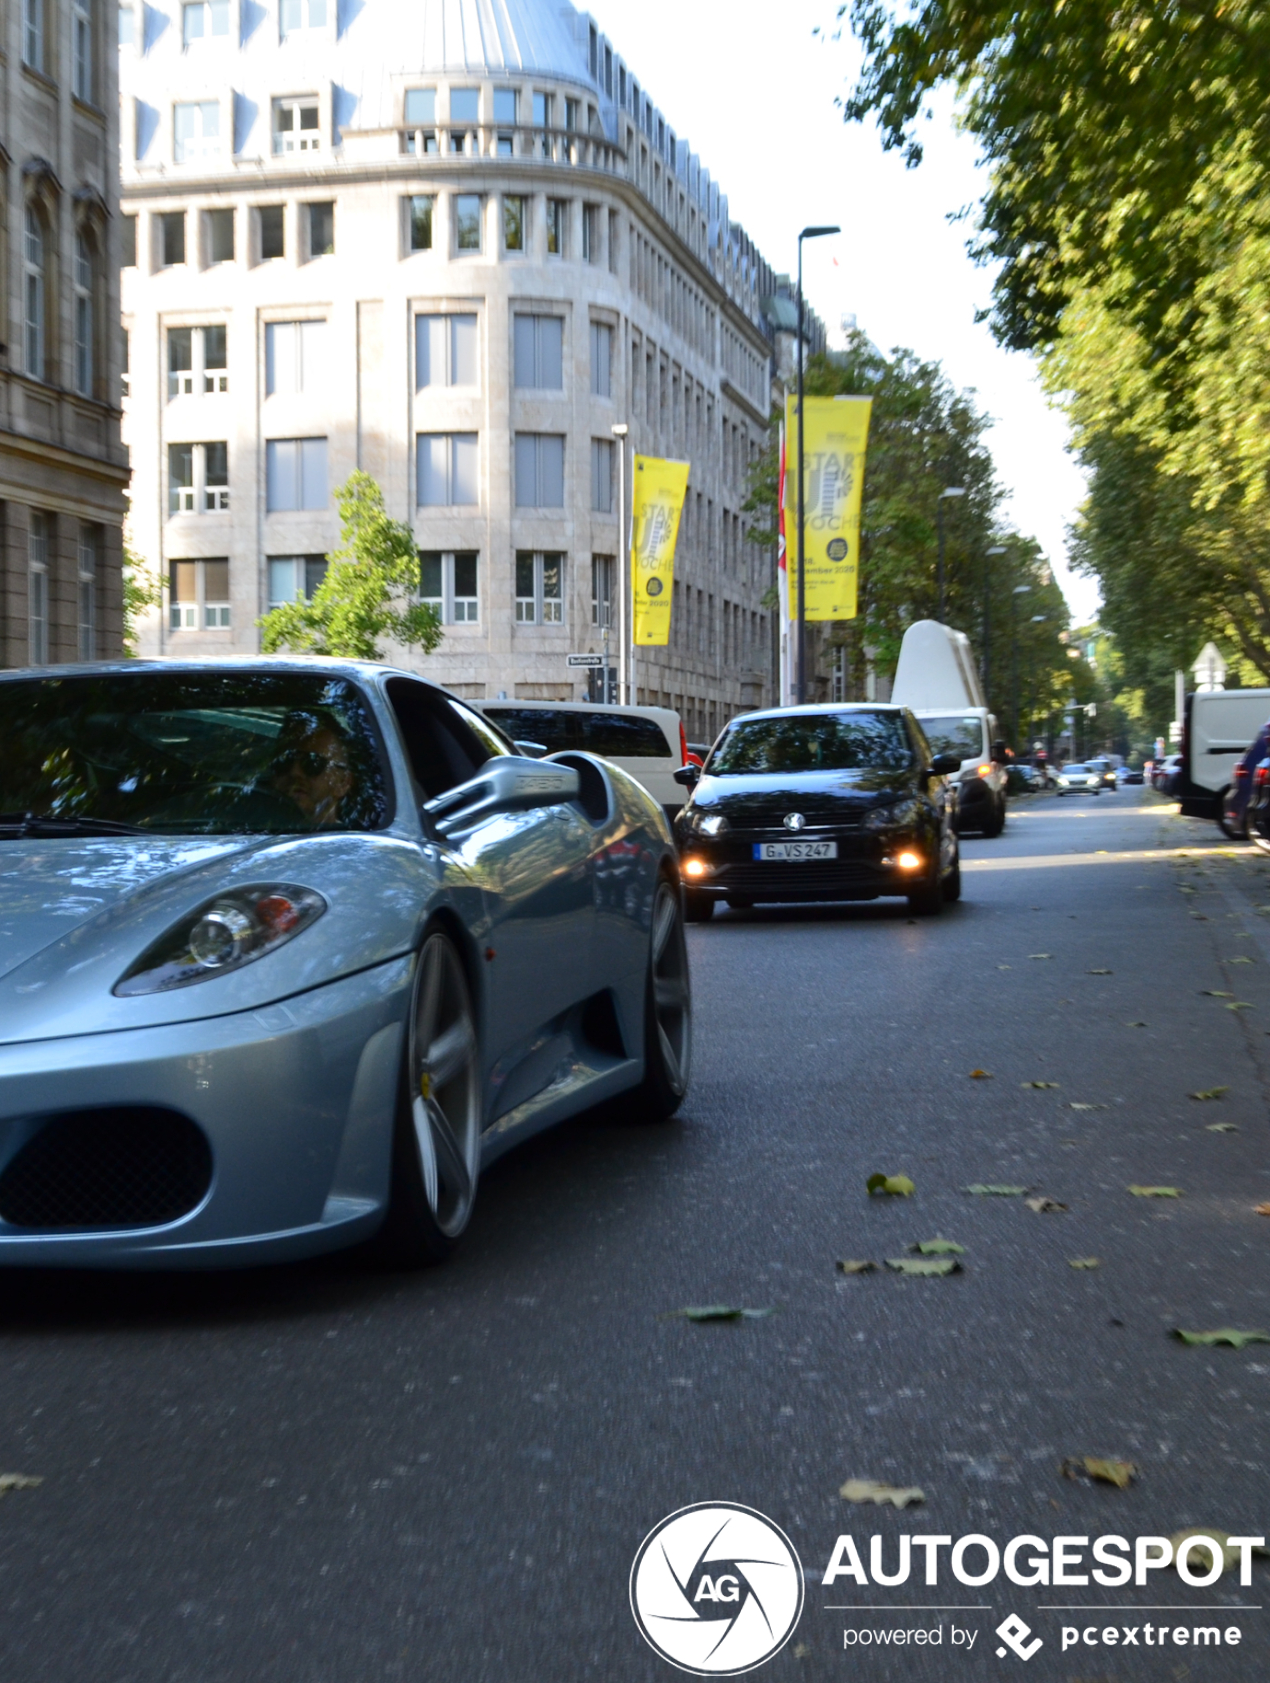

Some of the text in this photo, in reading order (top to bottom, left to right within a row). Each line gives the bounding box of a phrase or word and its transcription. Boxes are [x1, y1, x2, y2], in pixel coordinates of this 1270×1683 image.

[790, 565, 855, 576] Seember 2020
[649, 599, 669, 607] 2020
[766, 843, 830, 858] G VS 247
